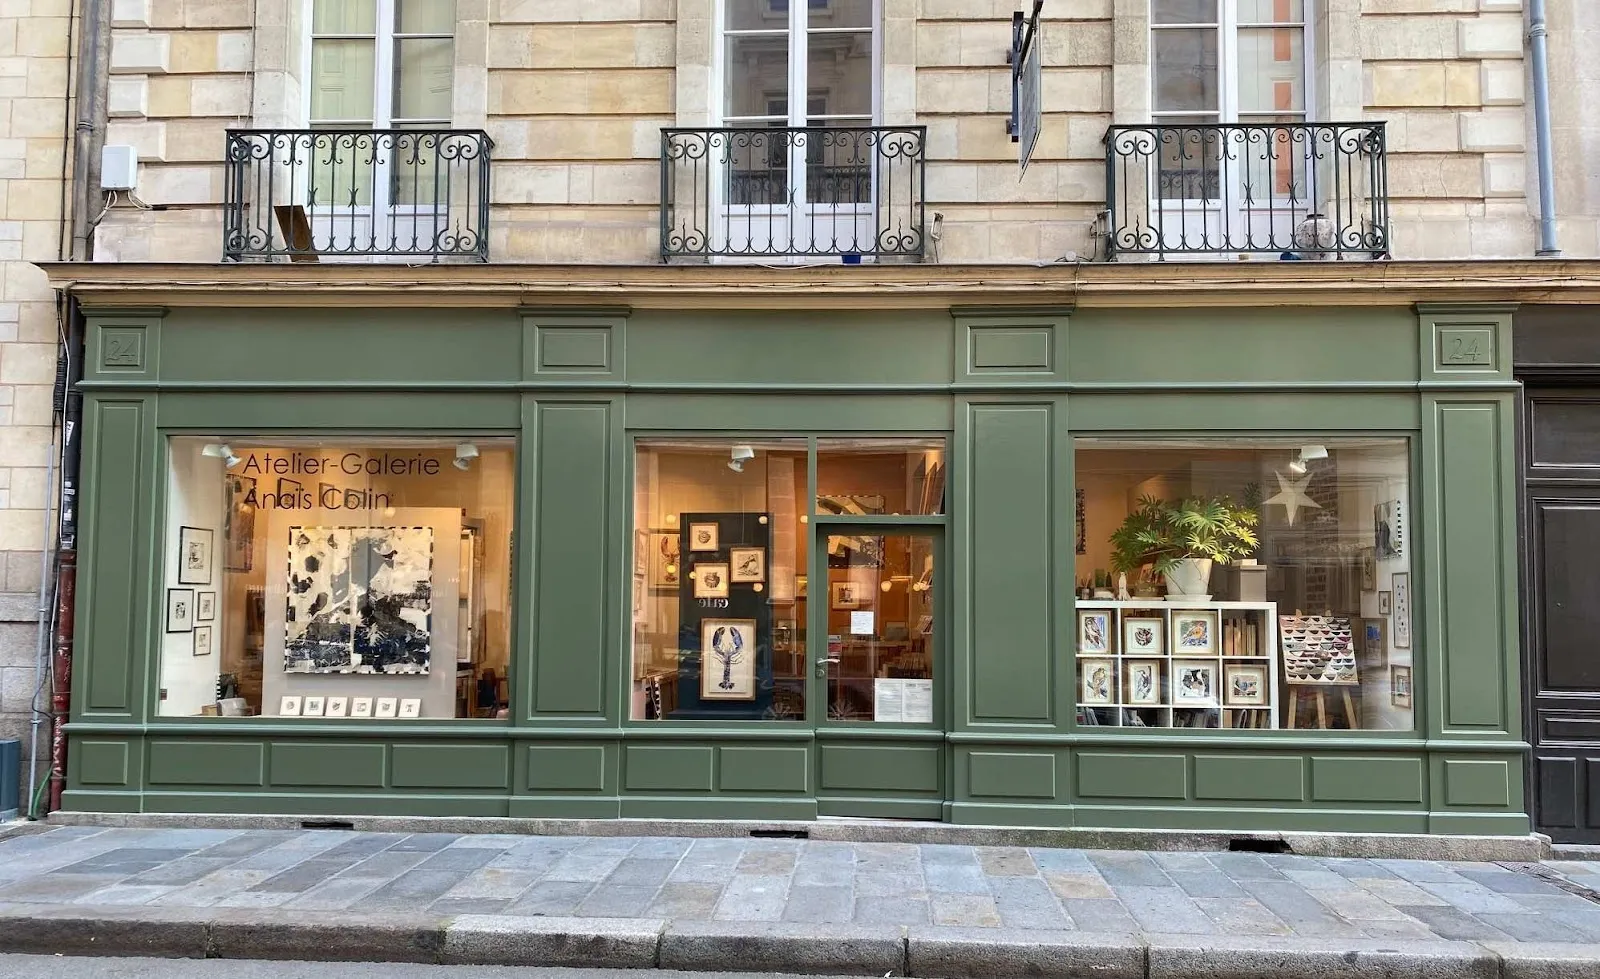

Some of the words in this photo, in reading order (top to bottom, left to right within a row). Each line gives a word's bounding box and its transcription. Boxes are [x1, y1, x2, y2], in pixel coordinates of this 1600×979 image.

[106, 338, 136, 362] 24
[1449, 337, 1481, 361] 24
[242, 452, 440, 476] Atelier-Galerie
[244, 487, 312, 510] Anaïs
[321, 487, 390, 510] Colin
